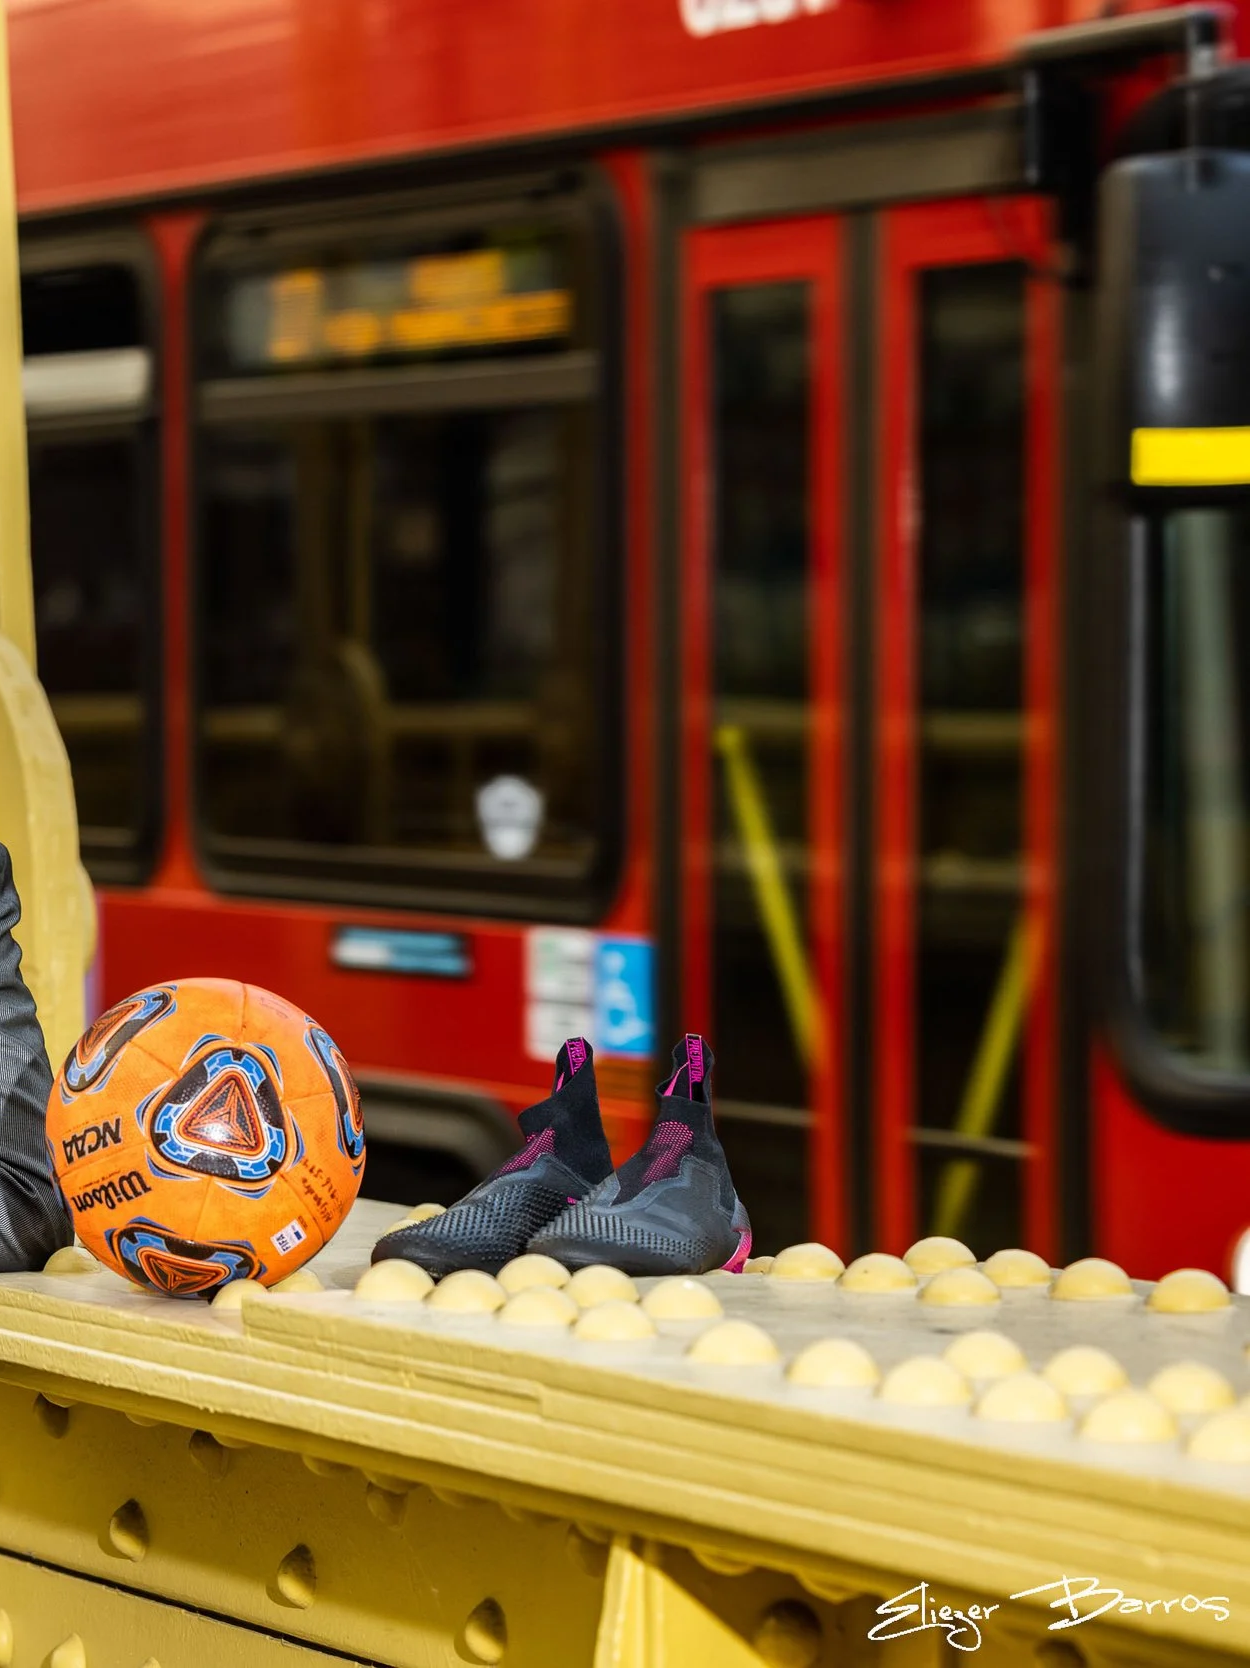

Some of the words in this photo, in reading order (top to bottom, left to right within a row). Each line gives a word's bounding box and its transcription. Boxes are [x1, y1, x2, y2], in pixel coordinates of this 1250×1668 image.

[688, 1038, 703, 1082] PREDATOR
[62, 1117, 122, 1165] NCAA
[71, 1170, 152, 1213] Wilson
[276, 1233, 292, 1252] FIFA
